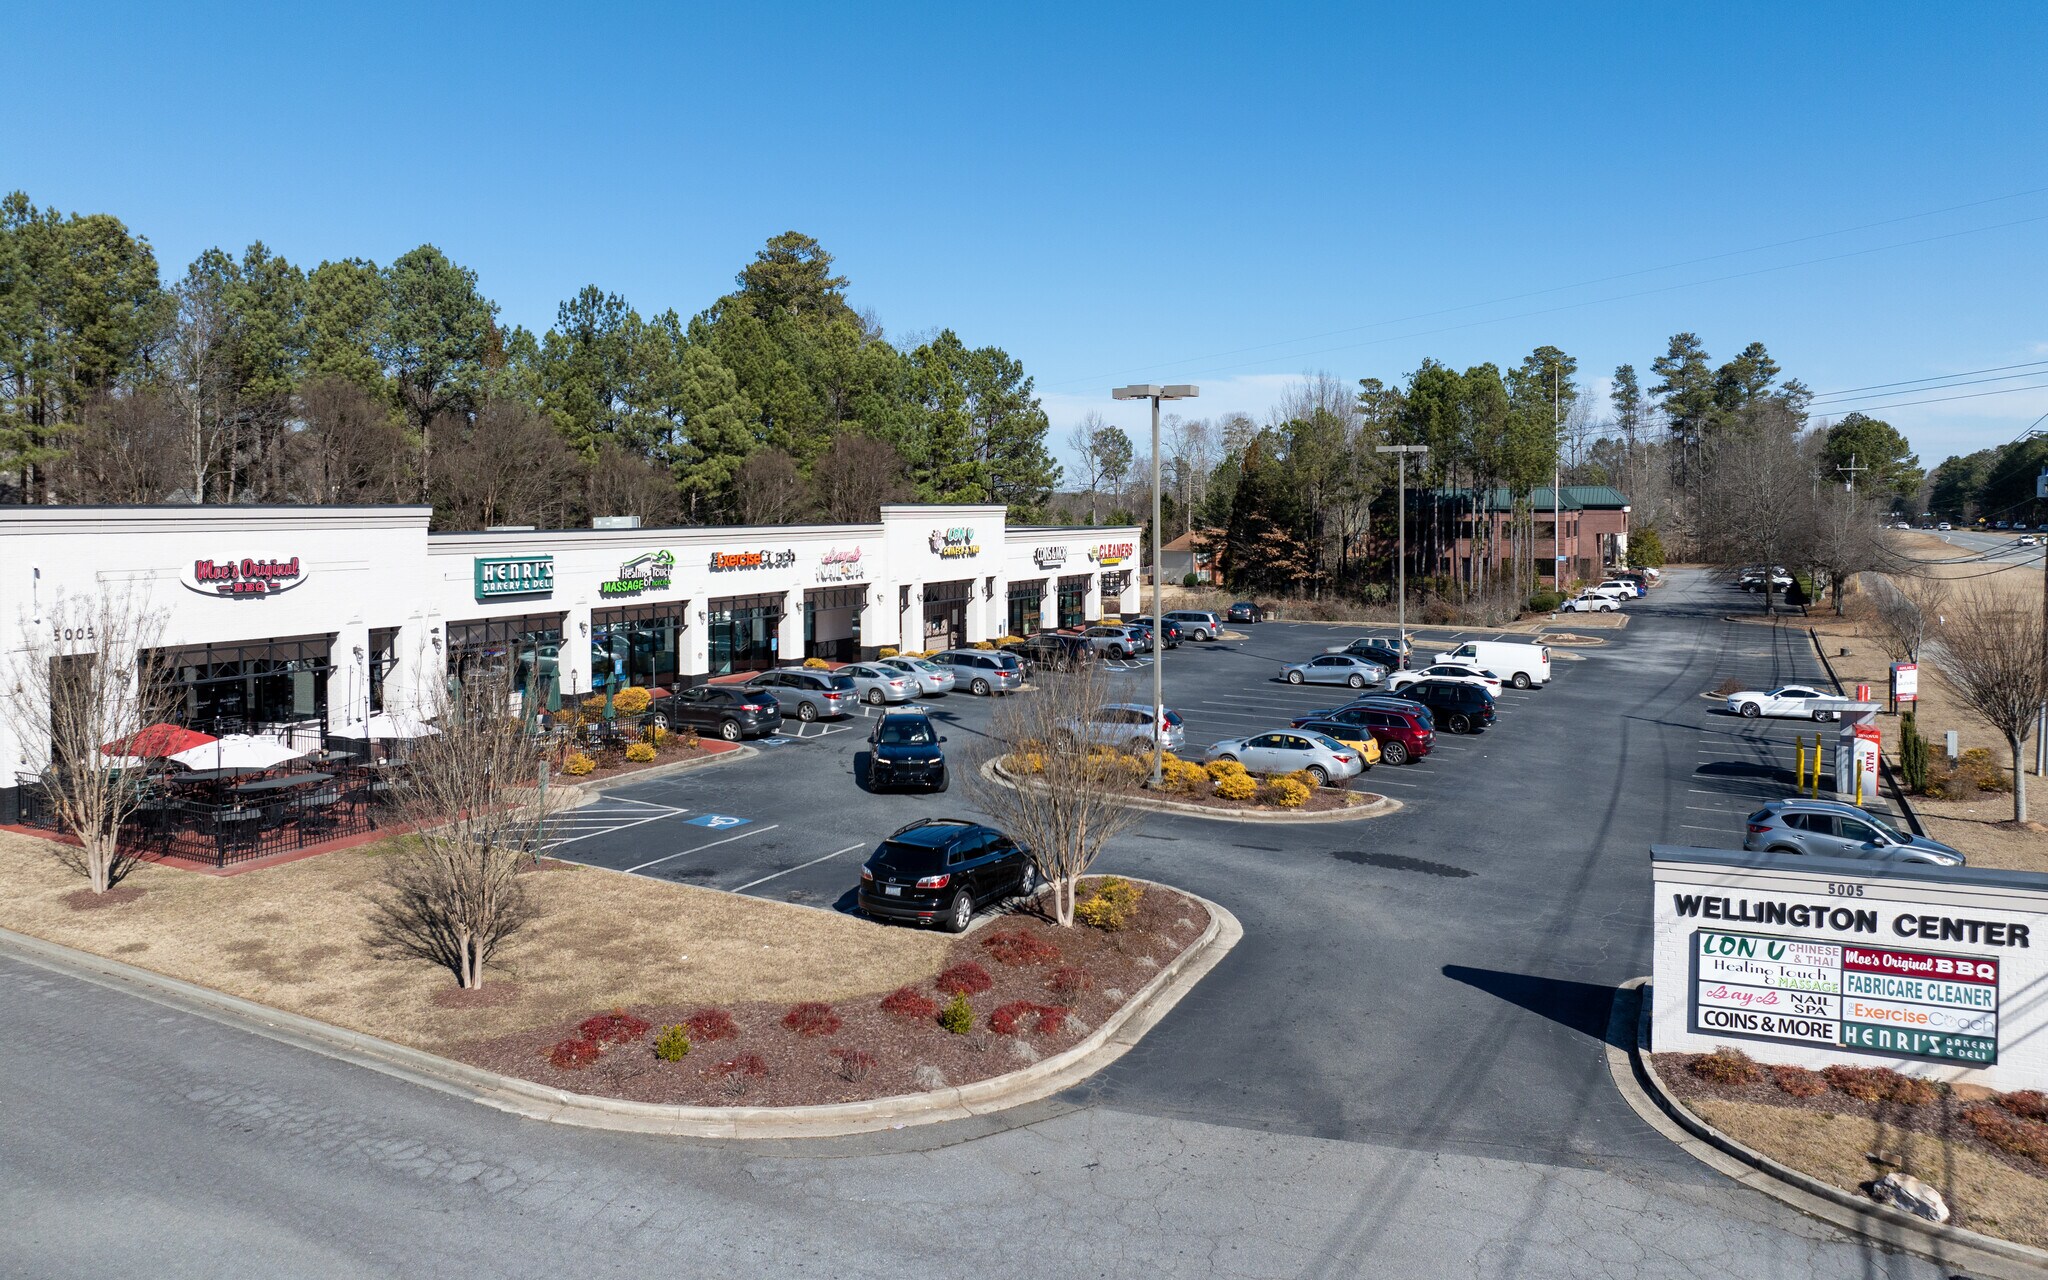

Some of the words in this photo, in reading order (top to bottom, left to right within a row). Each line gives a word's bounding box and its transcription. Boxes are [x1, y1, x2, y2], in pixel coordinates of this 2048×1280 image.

[1099, 543, 1133, 558] CLEANERS
[196, 560, 239, 581] Moe's
[241, 557, 299, 580] Original
[484, 562, 553, 581] HENRI'S
[233, 581, 265, 593] BBQ
[483, 581, 520, 591] BAKERY
[523, 580, 530, 589] &
[533, 579, 553, 588] DELI
[603, 580, 644, 592] MASSAGE
[54, 627, 95, 641] 5005
[1865, 751, 1875, 773] ATM
[1828, 883, 1864, 897] 5005
[1673, 893, 1877, 933] WELLINGTON
[1892, 913, 2030, 948] CENTER
[1703, 934, 1757, 958] LON
[1767, 940, 1786, 960] U
[1788, 943, 1840, 957] CHINESE
[1793, 954, 1802, 964] &
[1805, 955, 1834, 967] THAI
[1845, 949, 1880, 966] Moe's
[1882, 953, 1933, 972] Original
[1935, 958, 1995, 981] BBQ
[1714, 959, 1776, 985] Healing
[1780, 965, 1827, 981] Touch
[1778, 977, 1839, 993] MASSAGE
[1847, 974, 1923, 1000] FABRICARE
[1927, 983, 1993, 1008] CLEANER
[1790, 993, 1833, 1007] NAIL
[1794, 1004, 1828, 1016] SPA
[1703, 1010, 1759, 1032] COINS
[1760, 1016, 1775, 1032] &
[1778, 1018, 1833, 1039] MORE
[1845, 1025, 1941, 1054] HENRI'S
[1945, 1037, 1995, 1050] BAKERY
[1945, 1047, 1954, 1057] &
[1958, 1050, 1987, 1060] DELI
